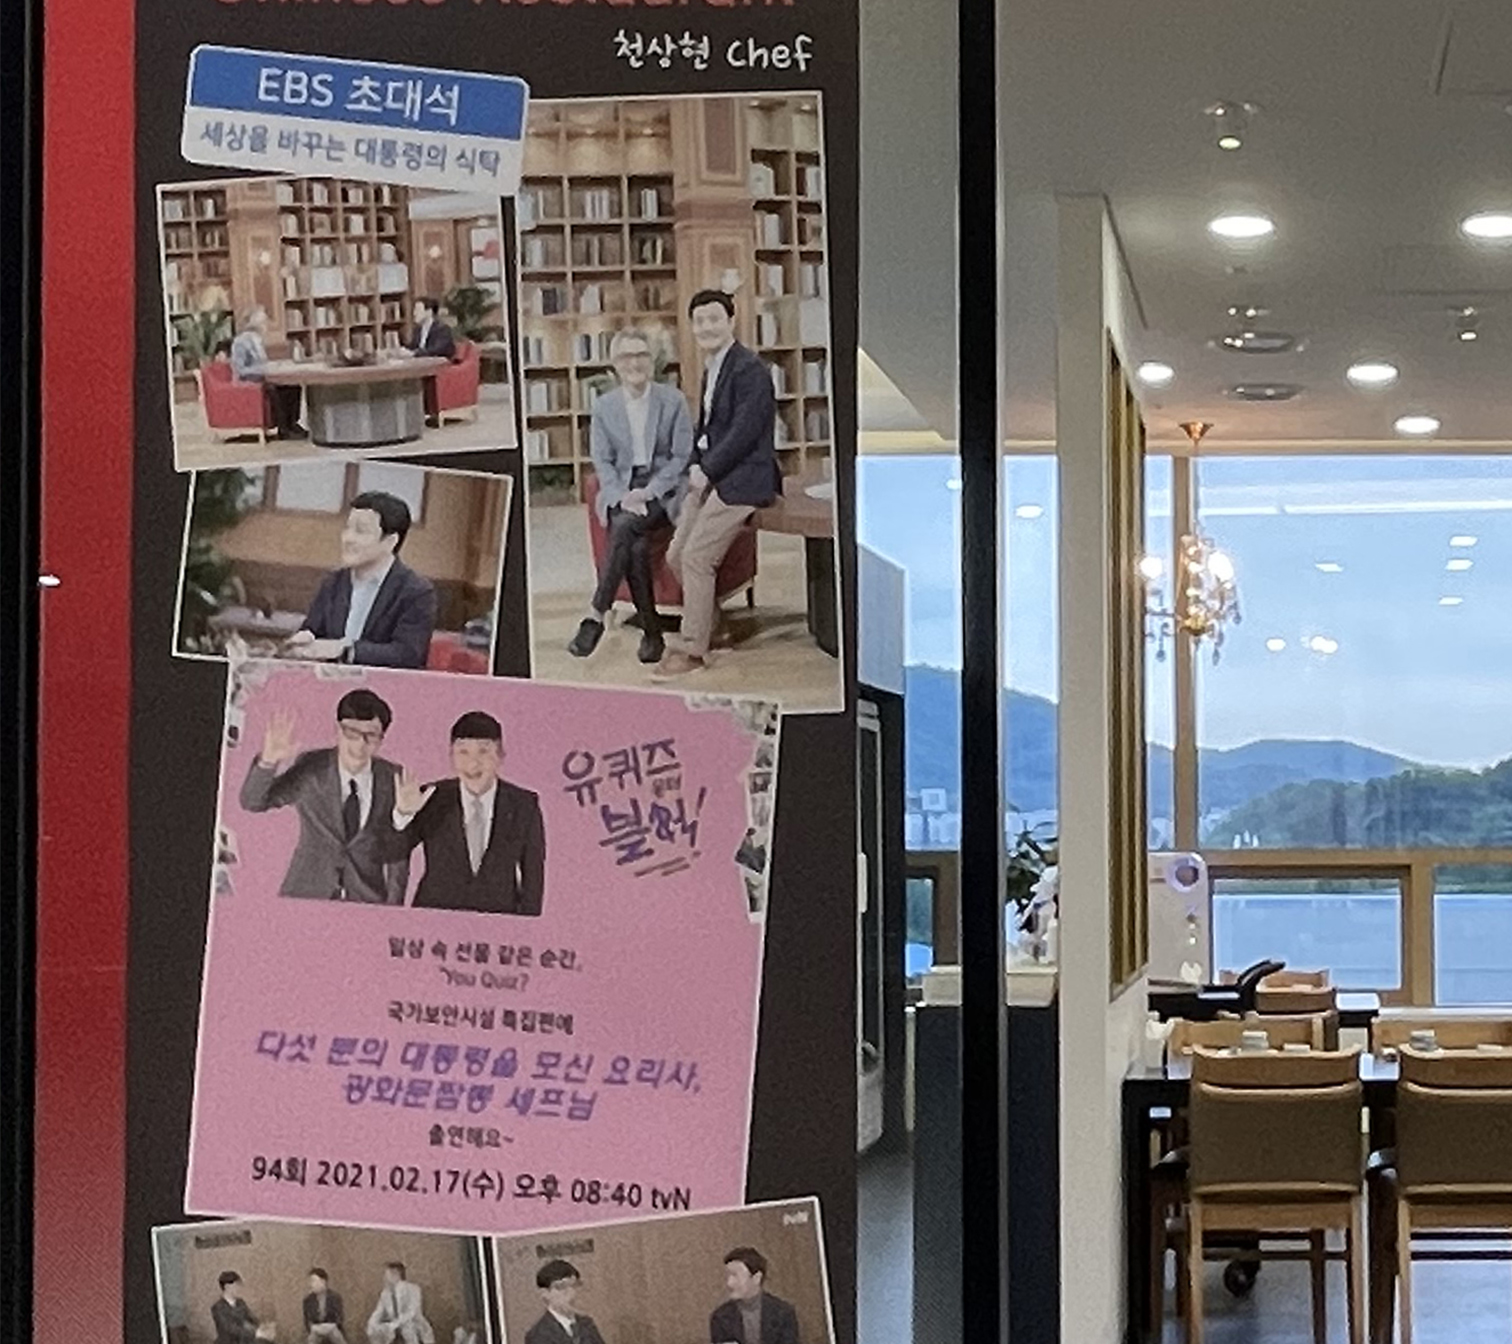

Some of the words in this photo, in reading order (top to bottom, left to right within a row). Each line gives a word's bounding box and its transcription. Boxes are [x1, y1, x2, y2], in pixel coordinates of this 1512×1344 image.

[613, 29, 710, 70] 천상현
[257, 67, 334, 107] EBS
[346, 75, 460, 126] 초대석
[200, 121, 269, 154] 세상을
[277, 129, 346, 162] 바꾸는
[354, 137, 447, 172] 대통령의
[455, 149, 501, 177] 식탁
[562, 738, 682, 807] 유퀴즈
[256, 1030, 318, 1063] 다섯
[327, 1036, 389, 1069] 분의
[400, 1041, 518, 1078] 대통령을
[530, 1050, 595, 1084] 모신
[251, 1155, 307, 1187] 94회
[317, 1160, 505, 1202] 2021.02.17(수)
[512, 1173, 563, 1205] 오후
[570, 1177, 643, 1209] 08:40
[650, 1186, 692, 1210] tvN
